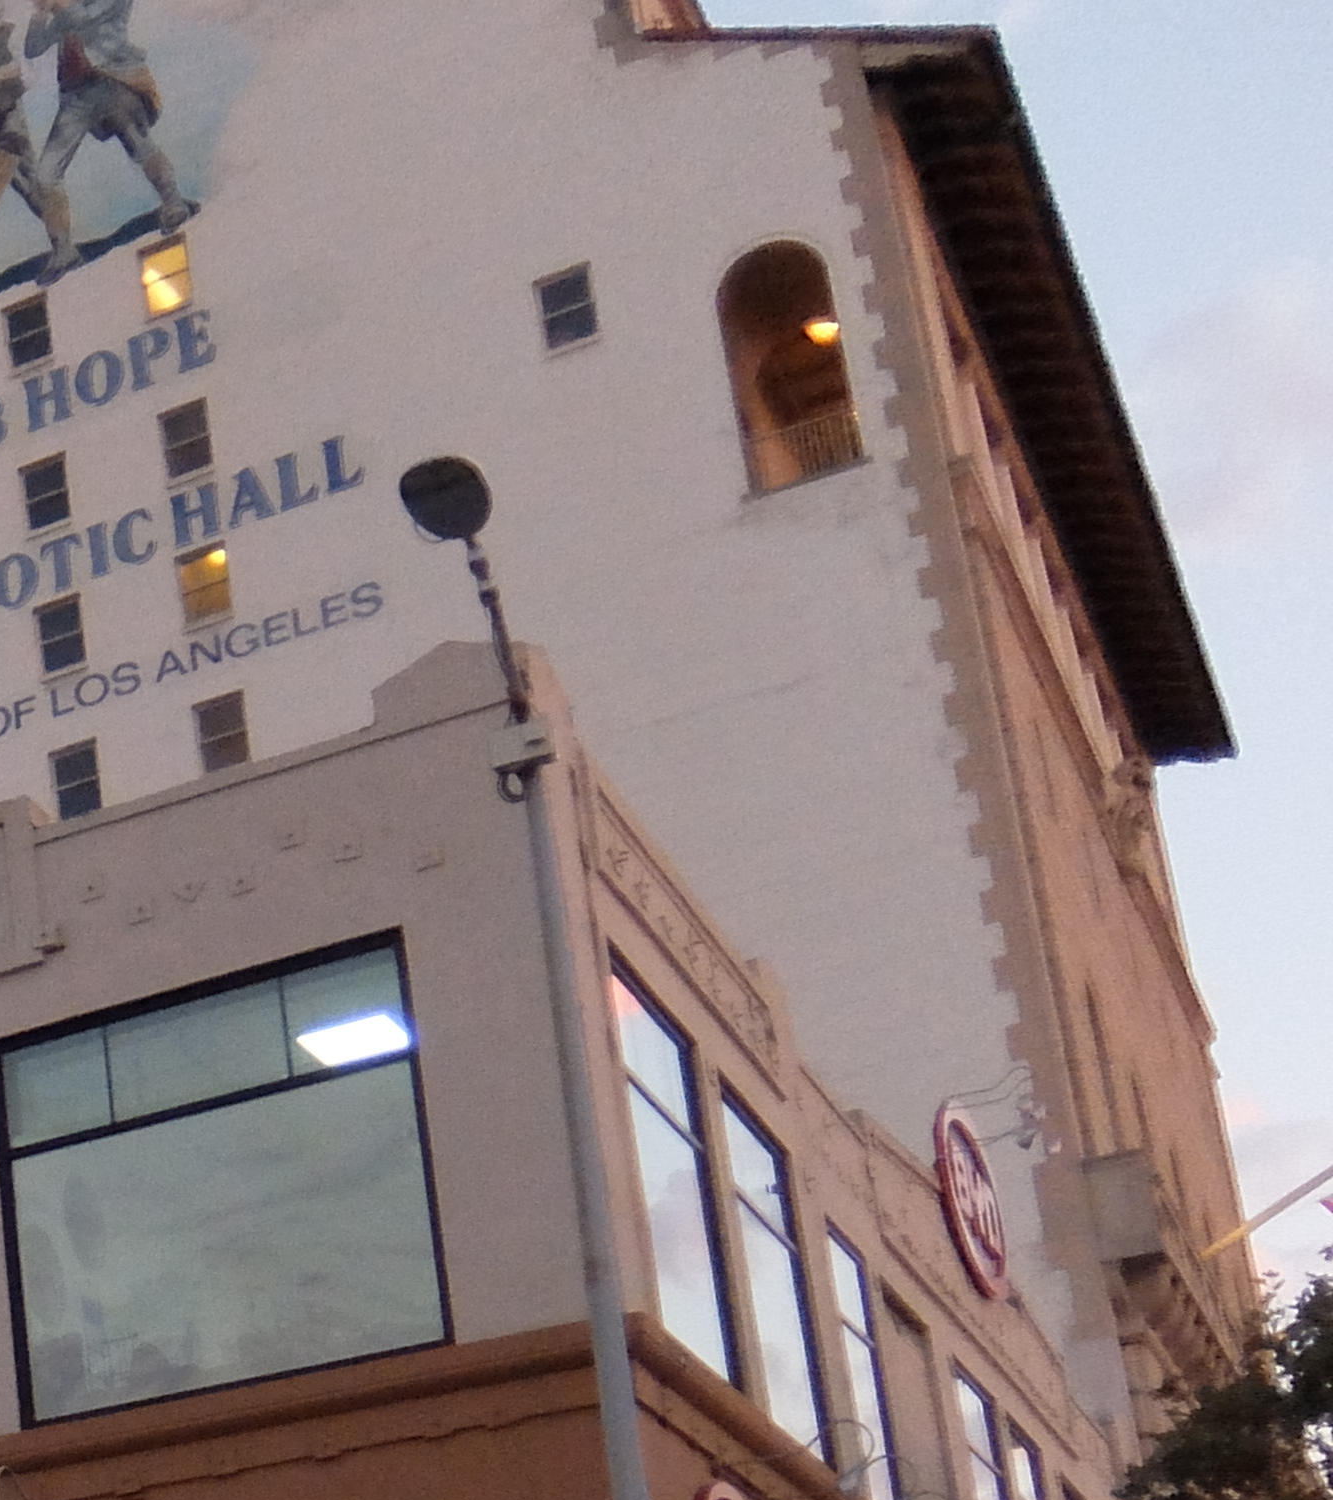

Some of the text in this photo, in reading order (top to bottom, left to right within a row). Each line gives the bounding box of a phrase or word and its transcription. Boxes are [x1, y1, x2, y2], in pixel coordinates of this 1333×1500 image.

[22, 309, 218, 434] HOPE
[169, 435, 366, 547] HALL
[50, 661, 143, 718] LOS
[155, 581, 385, 684] ANGELES
